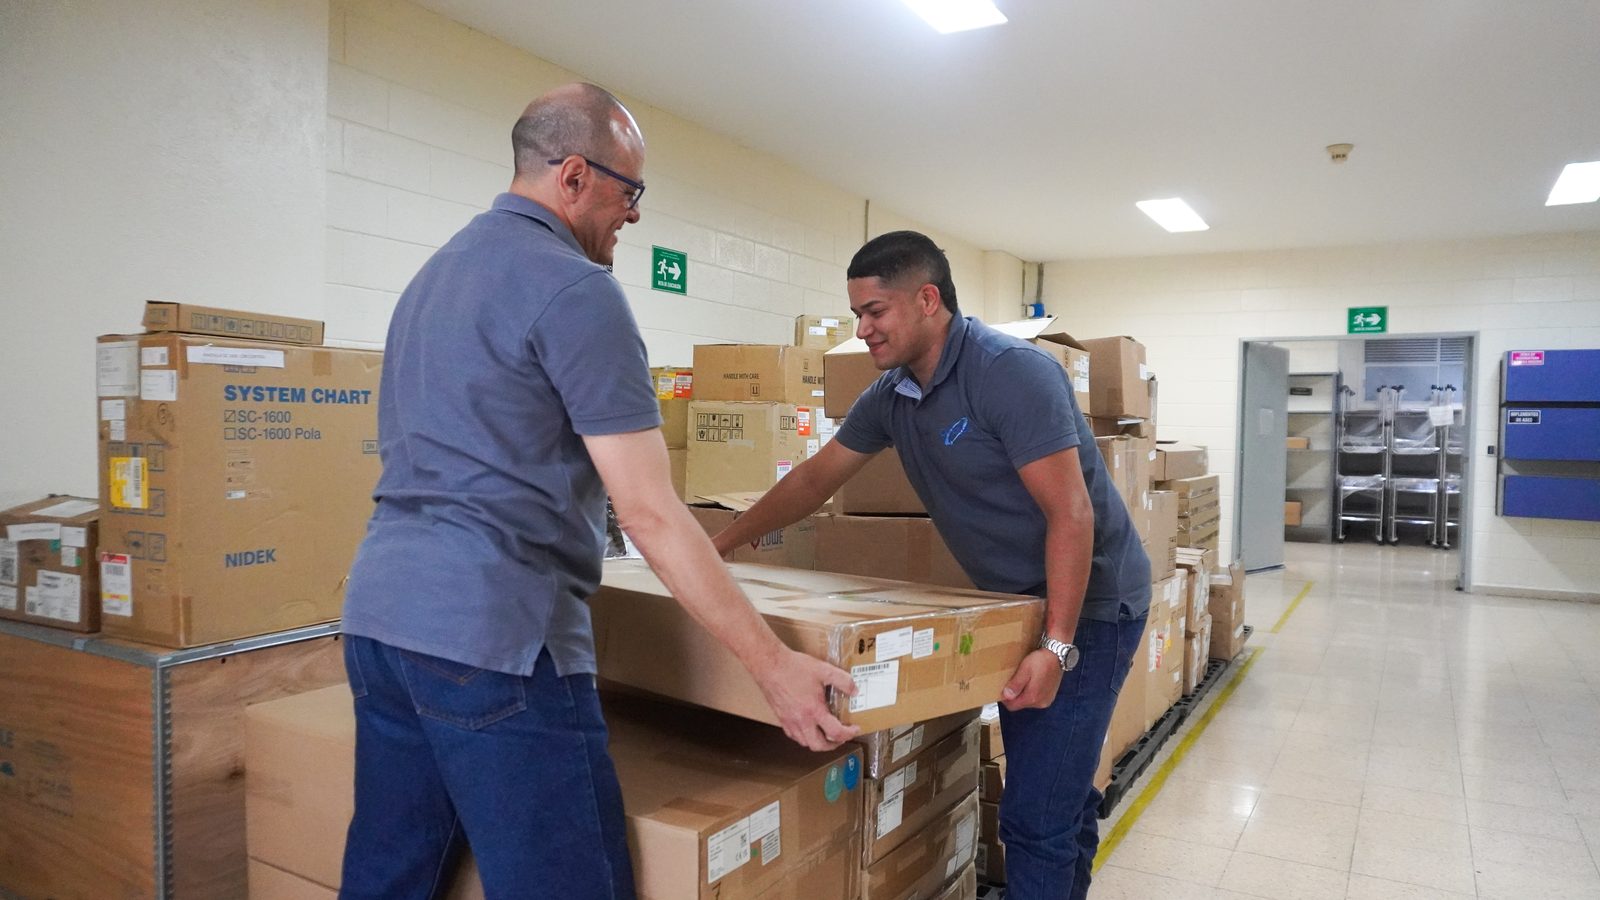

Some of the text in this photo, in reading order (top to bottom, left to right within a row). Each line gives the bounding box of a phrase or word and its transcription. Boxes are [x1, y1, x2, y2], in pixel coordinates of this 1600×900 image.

[723, 372, 738, 380] HANDLE
[802, 375, 817, 385] HANDLE
[224, 384, 371, 404] SYSTEM CHART
[237, 410, 291, 423] SC-1600
[237, 427, 321, 440] SC-1600 Pola
[225, 548, 276, 568] NIDEK
